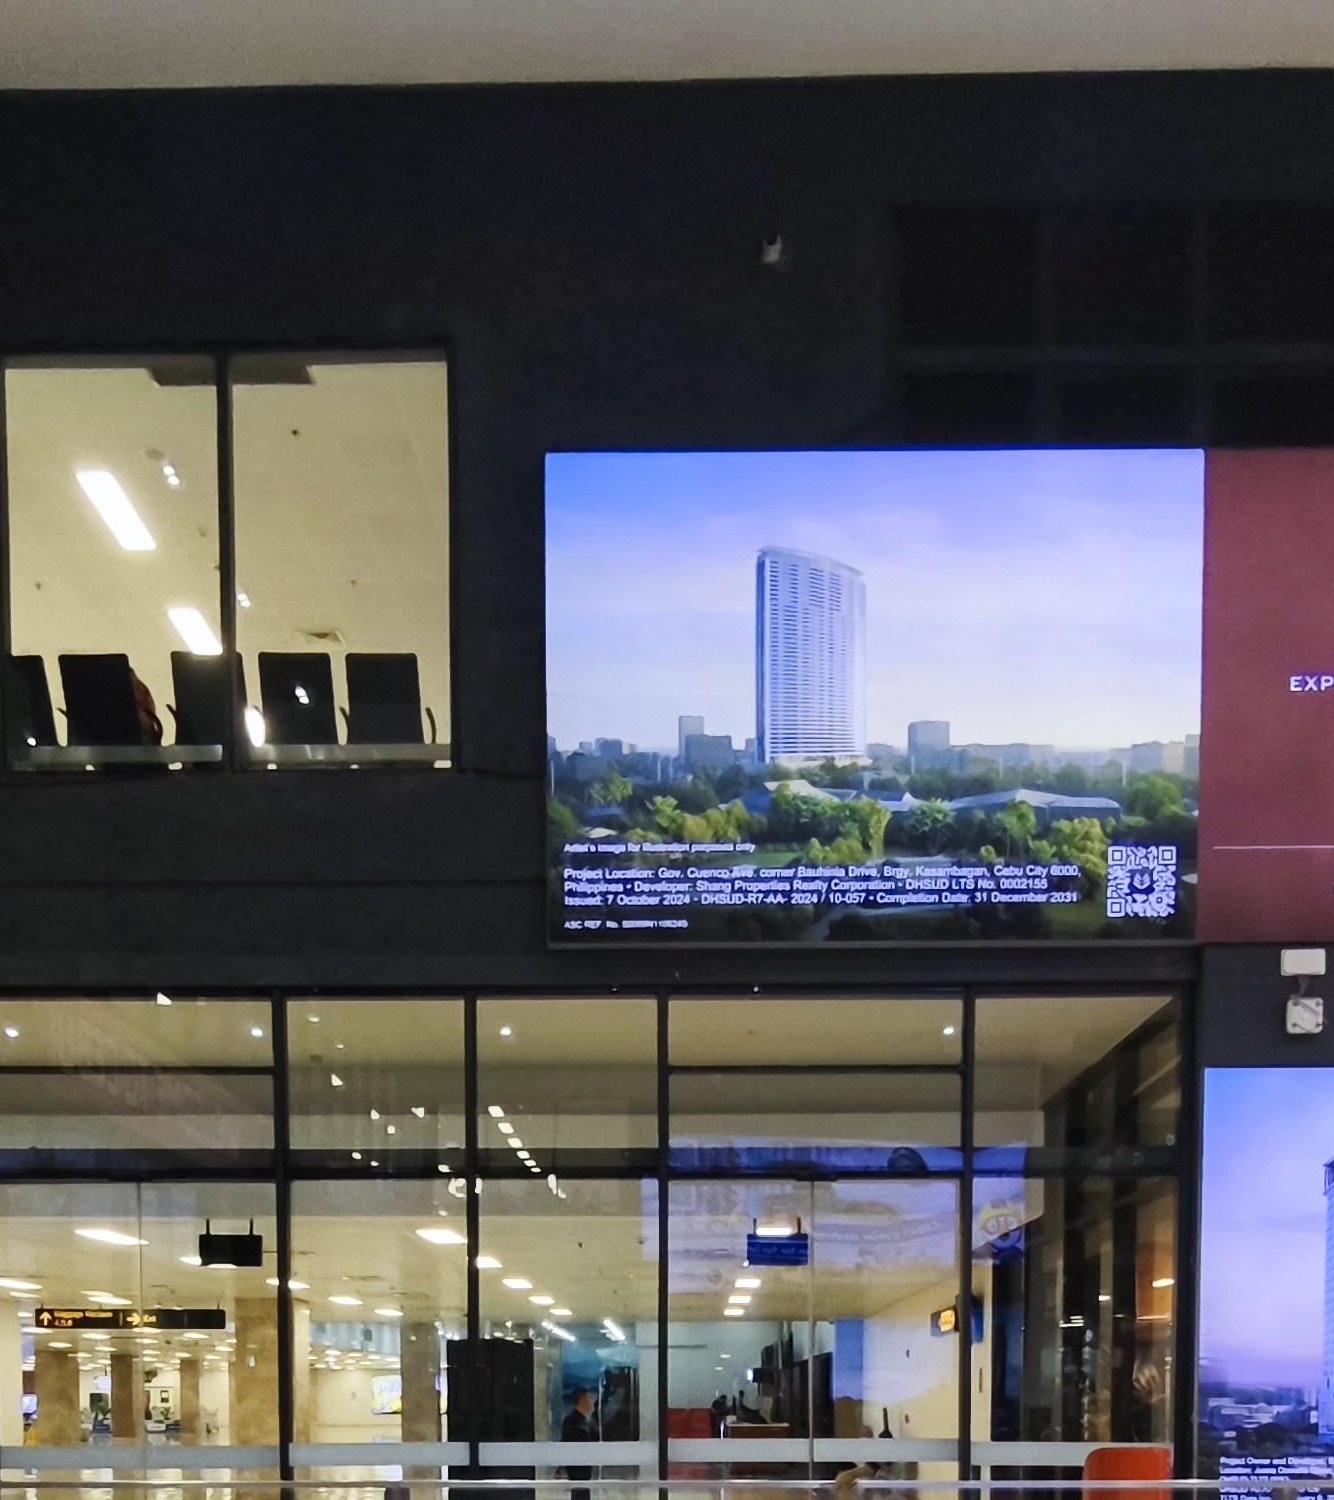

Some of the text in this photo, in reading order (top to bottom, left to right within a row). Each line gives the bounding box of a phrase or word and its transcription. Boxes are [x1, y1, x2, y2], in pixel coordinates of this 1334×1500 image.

[564, 867, 603, 881] Project
[657, 866, 685, 879] Gov.
[1025, 865, 1048, 879] City
[564, 881, 624, 894] Philippines
[695, 880, 732, 894] Shang
[734, 879, 791, 893] Properties
[830, 878, 895, 892] Corporation
[905, 878, 948, 890] DHSUD
[951, 878, 975, 890] LTS
[977, 878, 997, 890] No.
[606, 894, 615, 906] 7
[616, 893, 661, 906] October
[662, 893, 690, 905] 2024
[790, 892, 818, 905] 2024
[876, 891, 939, 906] Completion
[974, 891, 987, 904] 31
[990, 891, 1049, 904] December
